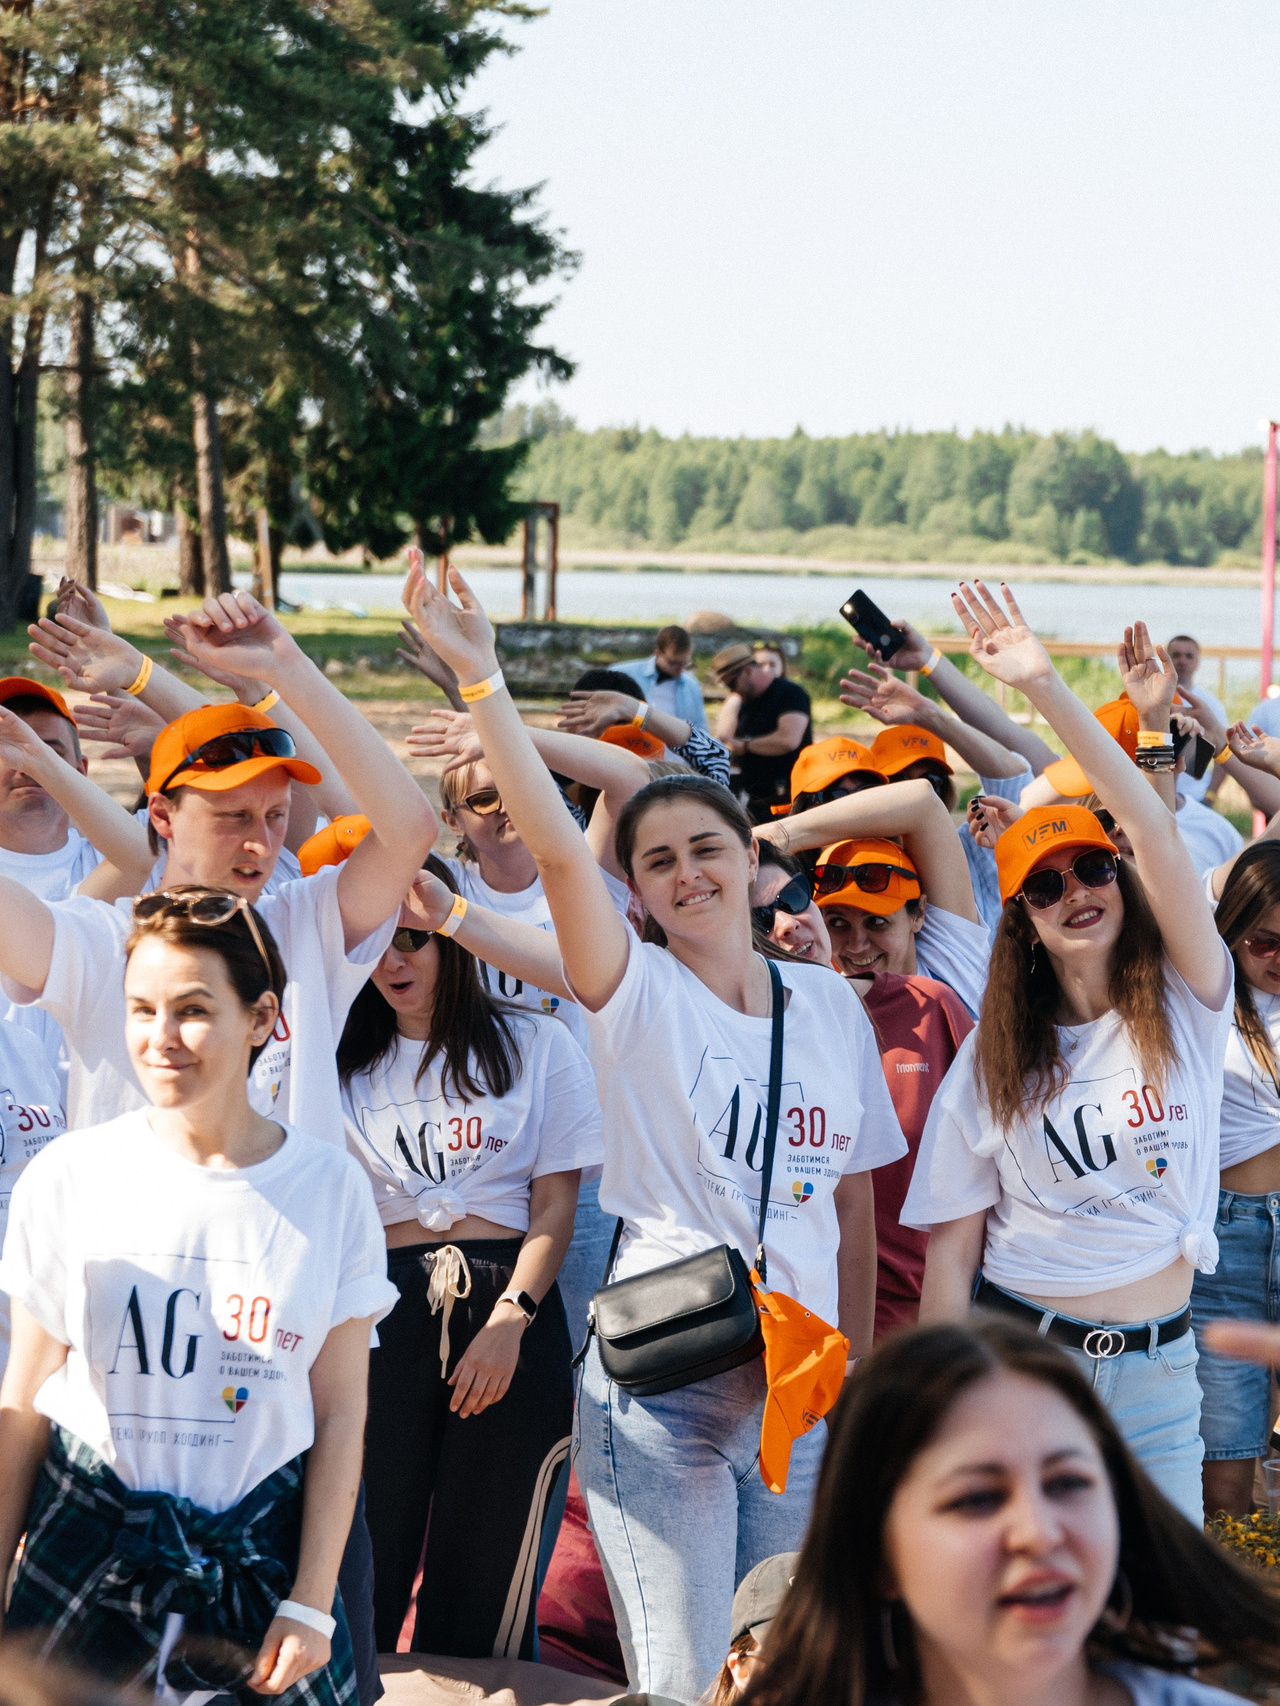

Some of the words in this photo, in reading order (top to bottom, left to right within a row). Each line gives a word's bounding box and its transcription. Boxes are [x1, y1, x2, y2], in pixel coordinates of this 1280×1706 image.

[902, 737, 929, 748] VFM
[828, 750, 858, 761] VFM
[1025, 820, 1067, 845] VFM
[8, 1104, 51, 1132] 30
[1121, 1084, 1165, 1128] 30
[448, 1116, 482, 1152] 30
[787, 1106, 826, 1148] 30
[831, 1133, 851, 1152] лет
[1133, 1129, 1169, 1145] ЗАБОТИМ
[394, 1121, 446, 1185] AG
[1043, 1103, 1118, 1184] AG
[1143, 1142, 1170, 1153] ВАШЕМ
[787, 1154, 830, 1164] ЗАБОТИМСЯ
[795, 1166, 821, 1175] ВАШЕМ
[751, 1205, 789, 1220] ХОДИНГ
[107, 1285, 204, 1379] AG
[222, 1294, 271, 1343] 30
[274, 1328, 304, 1353] лет
[229, 1366, 260, 1378] ВАШЕМ
